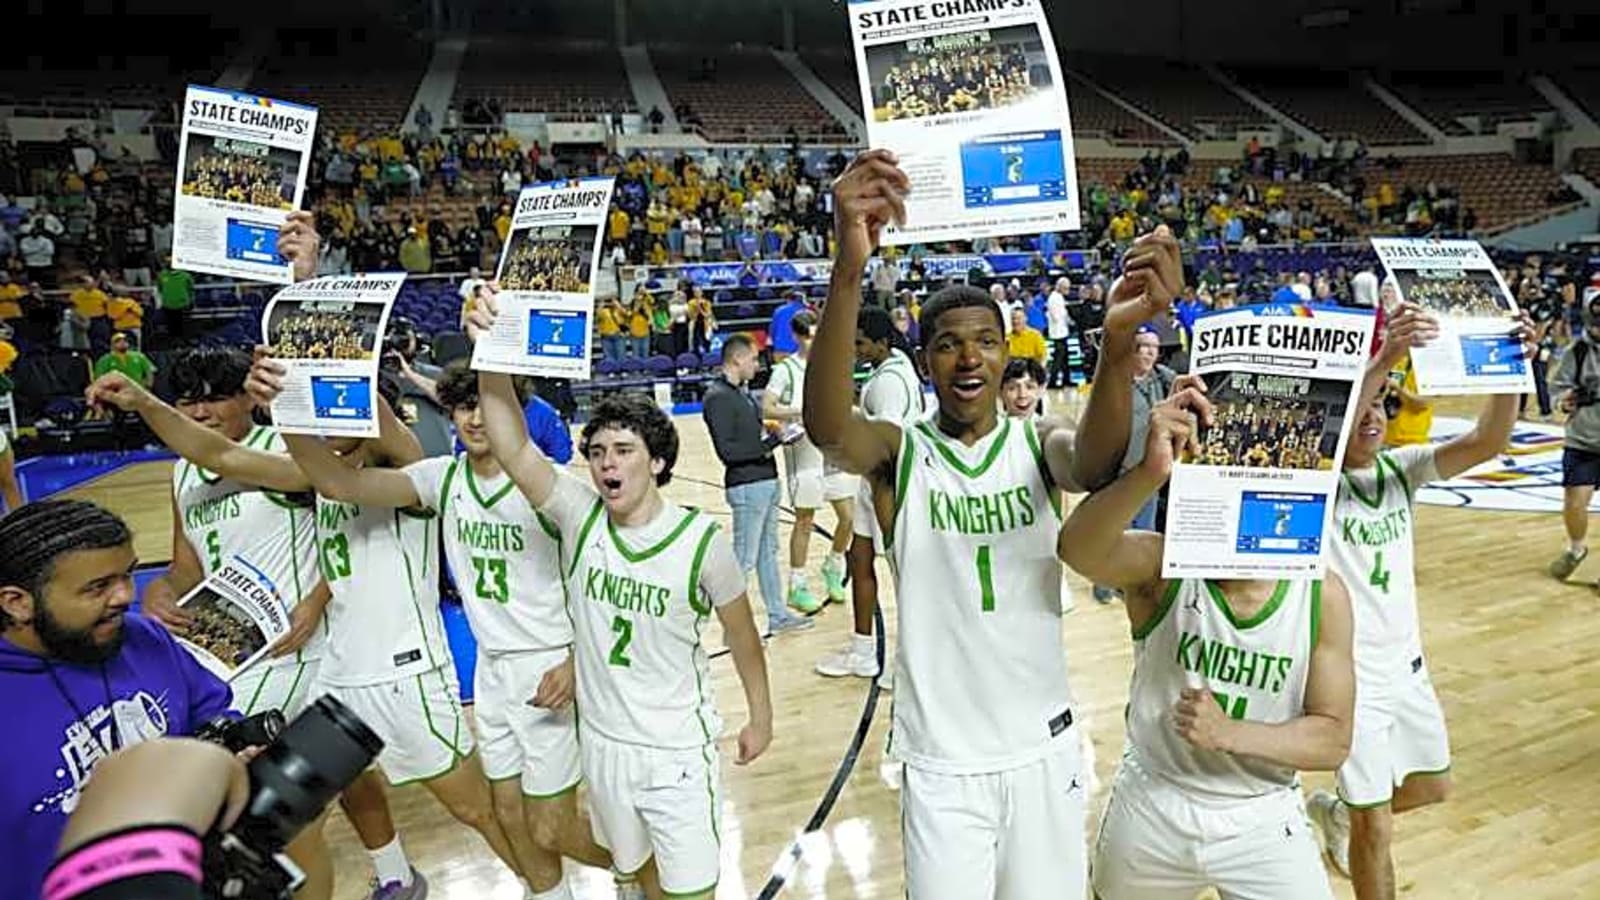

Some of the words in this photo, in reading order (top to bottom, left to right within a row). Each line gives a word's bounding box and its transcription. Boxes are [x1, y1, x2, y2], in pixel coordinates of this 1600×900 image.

[858, 5, 928, 29] STATE
[931, 0, 1033, 19] CHAMPS
[190, 99, 236, 122] STATE
[239, 107, 310, 135] CHAMPS!
[519, 196, 551, 214] STATE
[552, 190, 607, 210] CHAMPS!
[1380, 246, 1422, 257] STATE
[332, 279, 398, 291] CHAMPS!
[1198, 324, 1262, 352] STATE
[1267, 324, 1365, 356] CHAMPS!
[930, 485, 1036, 534] KNIGHTS
[1342, 508, 1407, 547] KNIGHTS
[206, 529, 222, 573] 5
[219, 566, 257, 593] STATE
[976, 545, 996, 611] 1
[1369, 551, 1390, 594] 4
[585, 567, 671, 618] KNIGHTS
[608, 616, 633, 668] 2
[1176, 631, 1293, 693] KNIGHTS
